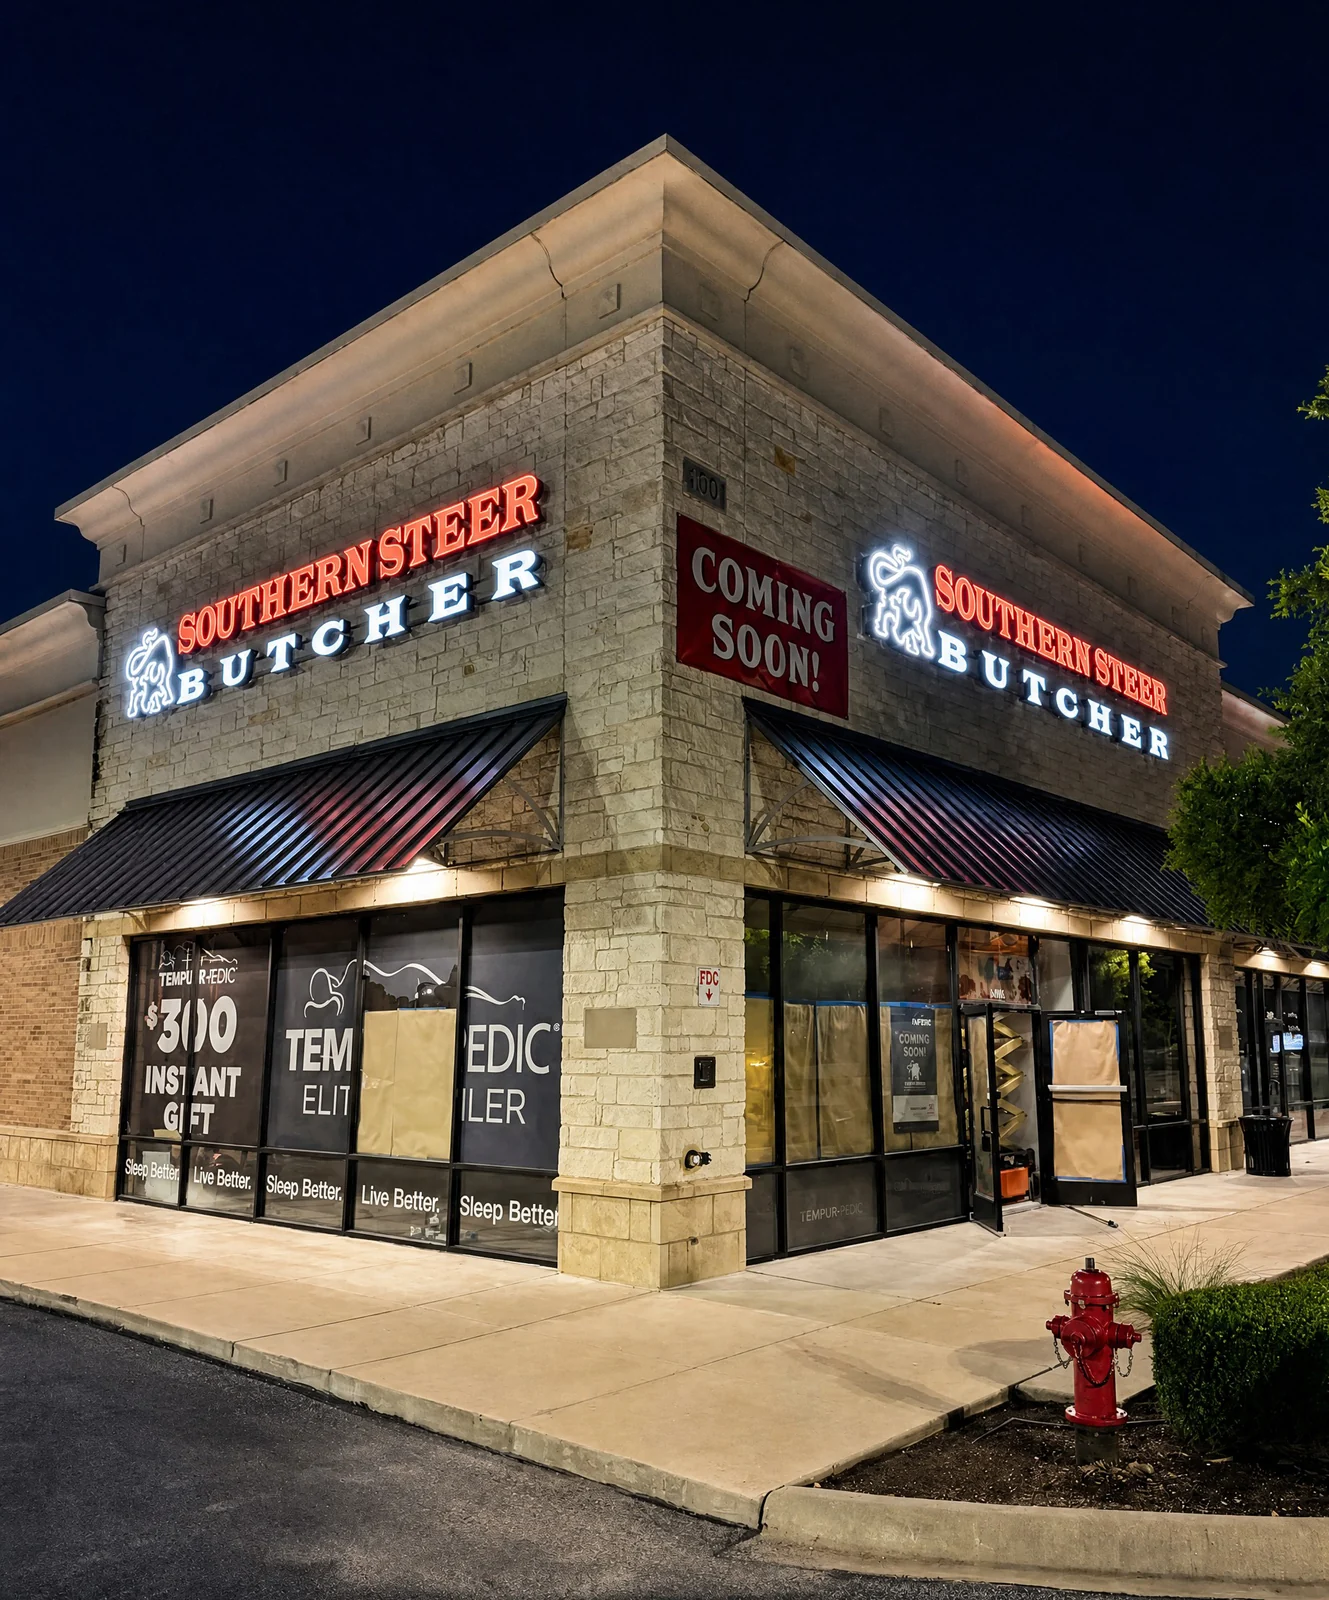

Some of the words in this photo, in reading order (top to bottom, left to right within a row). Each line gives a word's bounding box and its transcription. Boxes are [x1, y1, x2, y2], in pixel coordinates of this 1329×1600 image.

[179, 540, 372, 654] SOUTHERN
[379, 474, 539, 578] STEER
[692, 547, 834, 642] COMING
[176, 550, 538, 704] BUTCHER
[935, 565, 1091, 677] SOUTHERN
[1094, 648, 1167, 715] STEER
[712, 614, 819, 692] SOON!
[938, 630, 1168, 760] BUTCHER
[700, 970, 719, 986] FDC
[145, 995, 237, 1053] $300
[899, 1033, 930, 1045] COMING
[464, 1023, 551, 1074] EDIC
[904, 1047, 926, 1057] SOON!
[164, 1101, 215, 1134] GIFT
[125, 1158, 148, 1180] Sleep
[151, 1162, 179, 1181] Better.
[193, 1166, 214, 1185] Live
[217, 1169, 251, 1189] Better.
[266, 1175, 298, 1199] Sleep
[302, 1178, 342, 1200] Better.
[361, 1185, 389, 1206] Live
[394, 1188, 440, 1213] Better.
[460, 1195, 503, 1225] Sleep
[800, 1203, 863, 1222] TEMPUR-PEDIC
